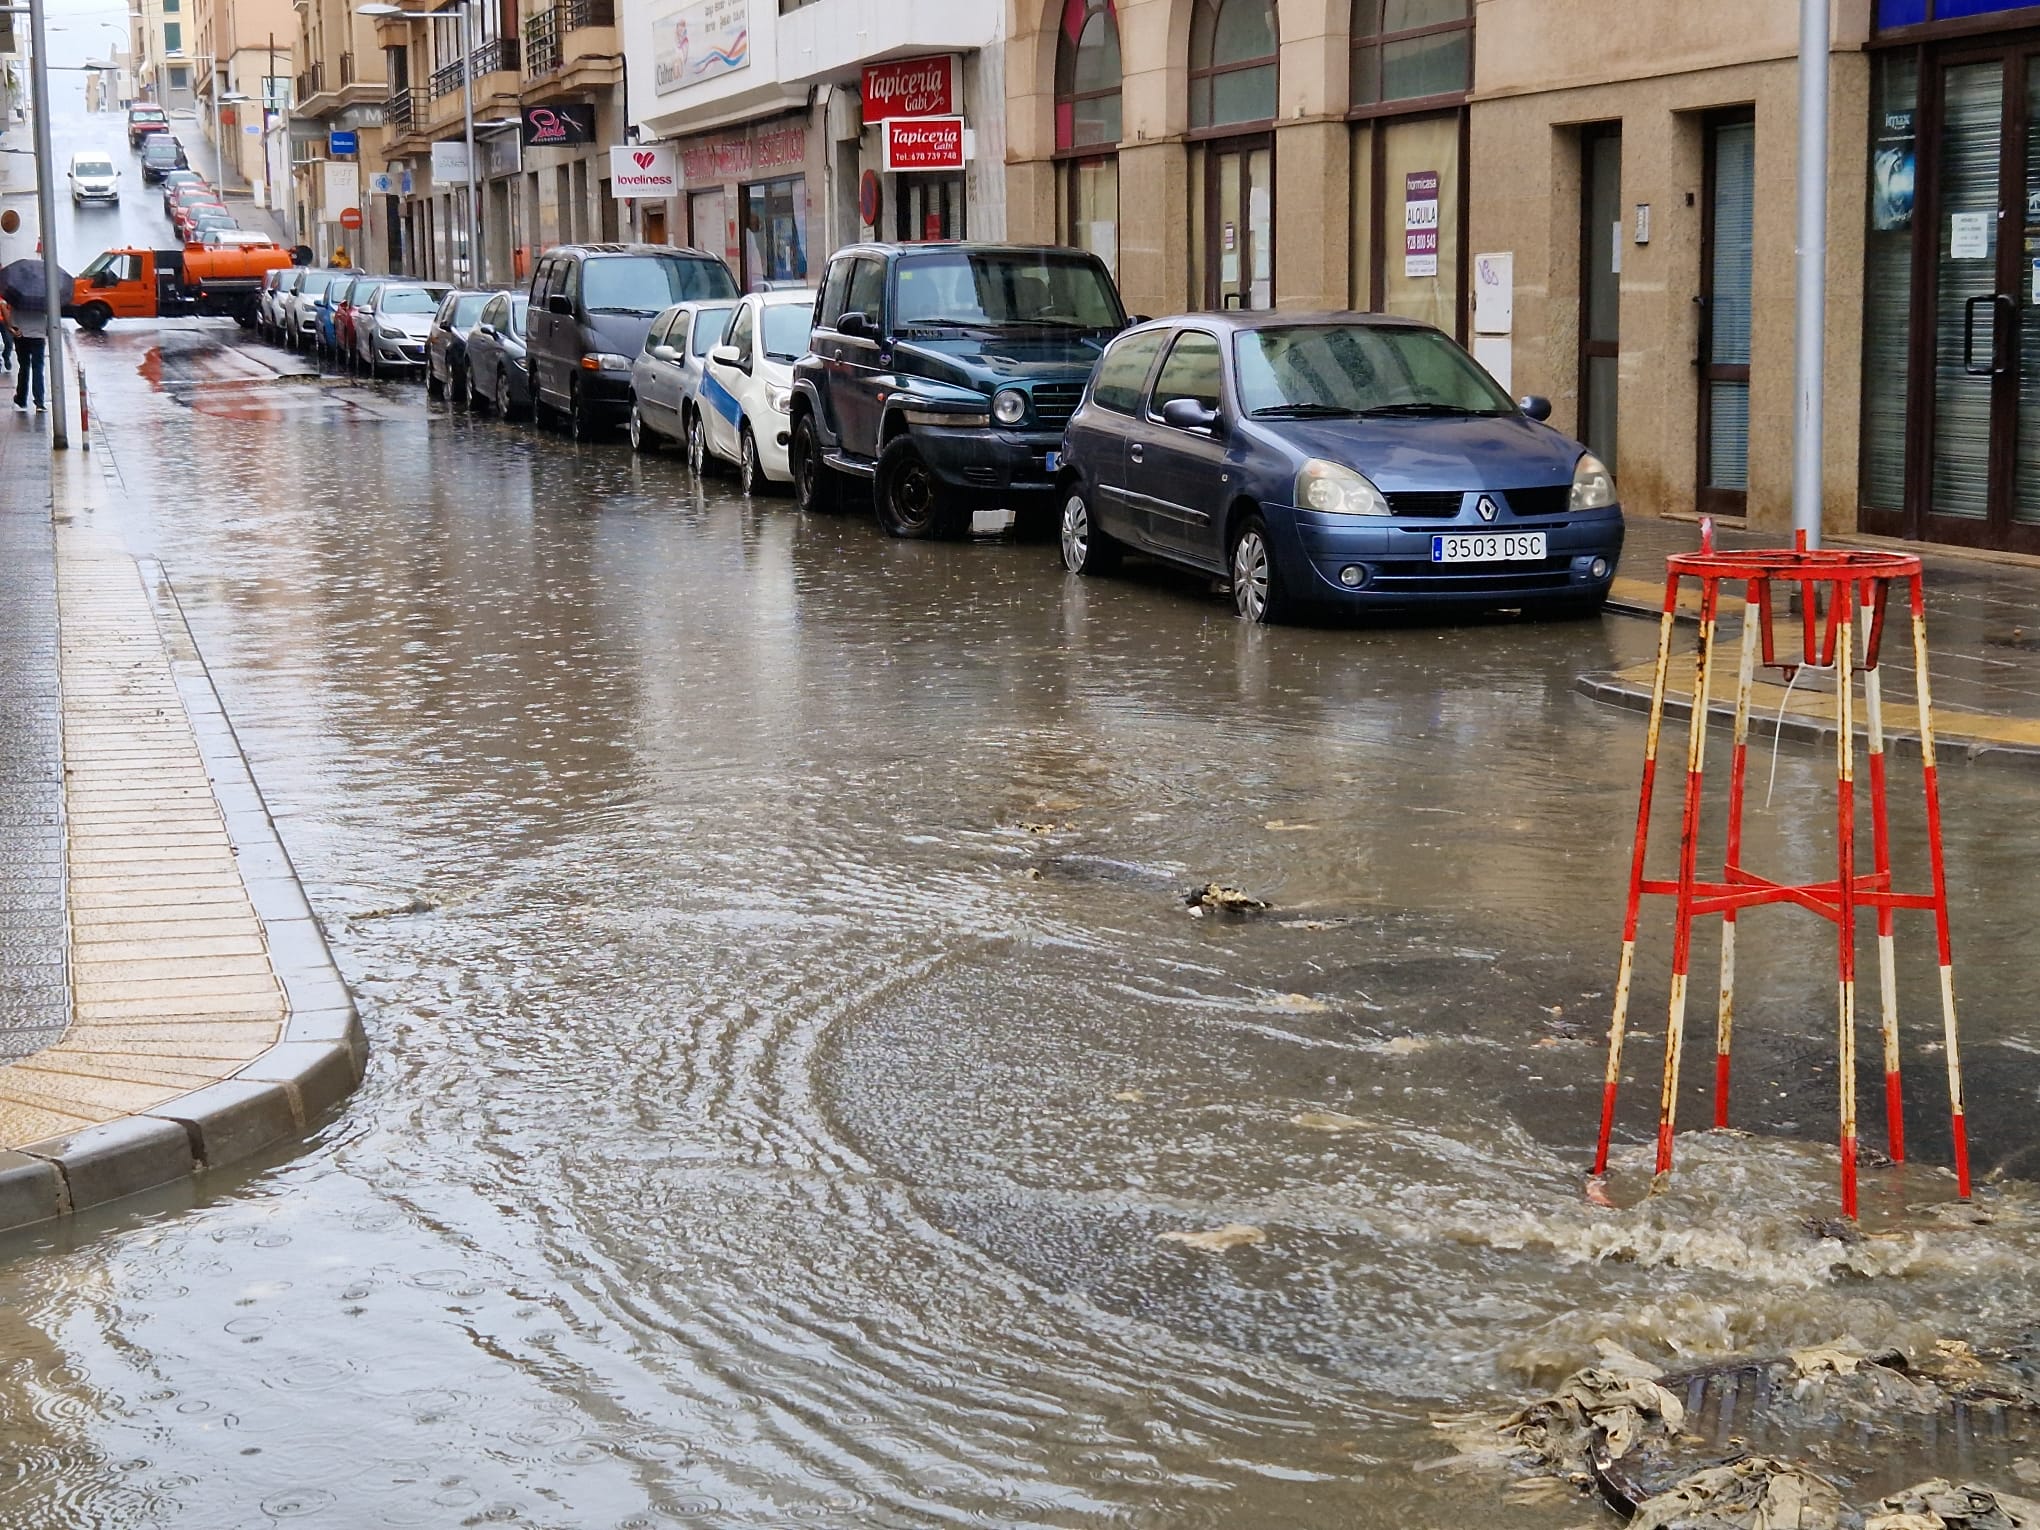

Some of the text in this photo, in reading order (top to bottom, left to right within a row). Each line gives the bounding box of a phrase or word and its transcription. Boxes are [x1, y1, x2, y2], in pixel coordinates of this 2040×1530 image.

[868, 63, 943, 104] Tapicería
[904, 92, 929, 112] Gabi
[893, 127, 959, 147] Tapicería
[934, 140, 954, 151] Gabi
[927, 152, 942, 161] 739
[617, 175, 672, 185] loveliness
[1407, 206, 1436, 225] ALQUILA
[1447, 538, 1497, 558] 3503
[1504, 536, 1541, 556] DSC
